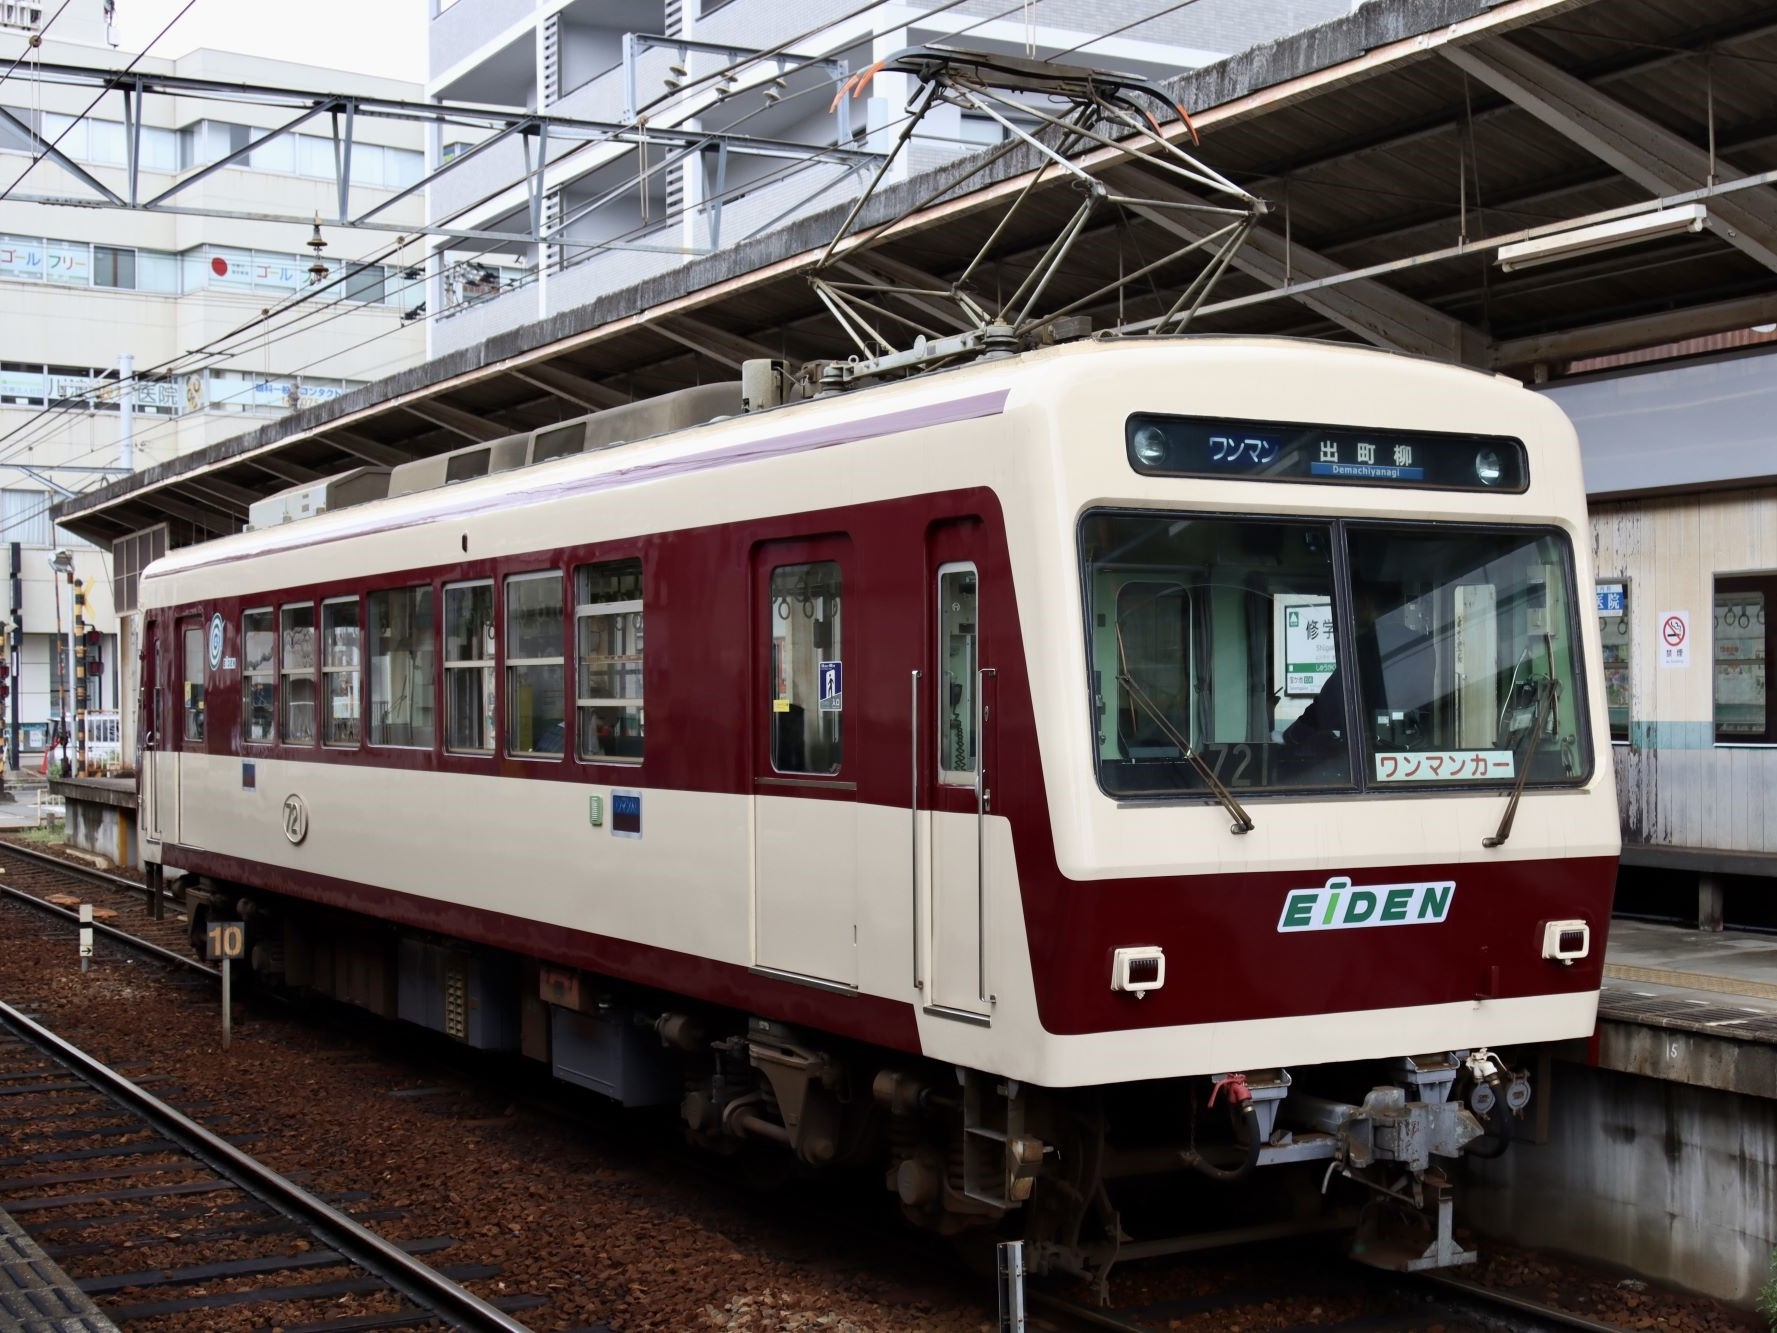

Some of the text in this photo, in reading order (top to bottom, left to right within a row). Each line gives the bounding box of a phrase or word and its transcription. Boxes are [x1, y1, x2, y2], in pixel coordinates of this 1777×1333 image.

[1209, 436, 1279, 463] ワンマン
[1319, 440, 1412, 466] 出町柳
[1332, 465, 1400, 478] Demachiyanagi
[1380, 753, 1510, 778] ワンマンカー
[208, 925, 243, 958] 10
